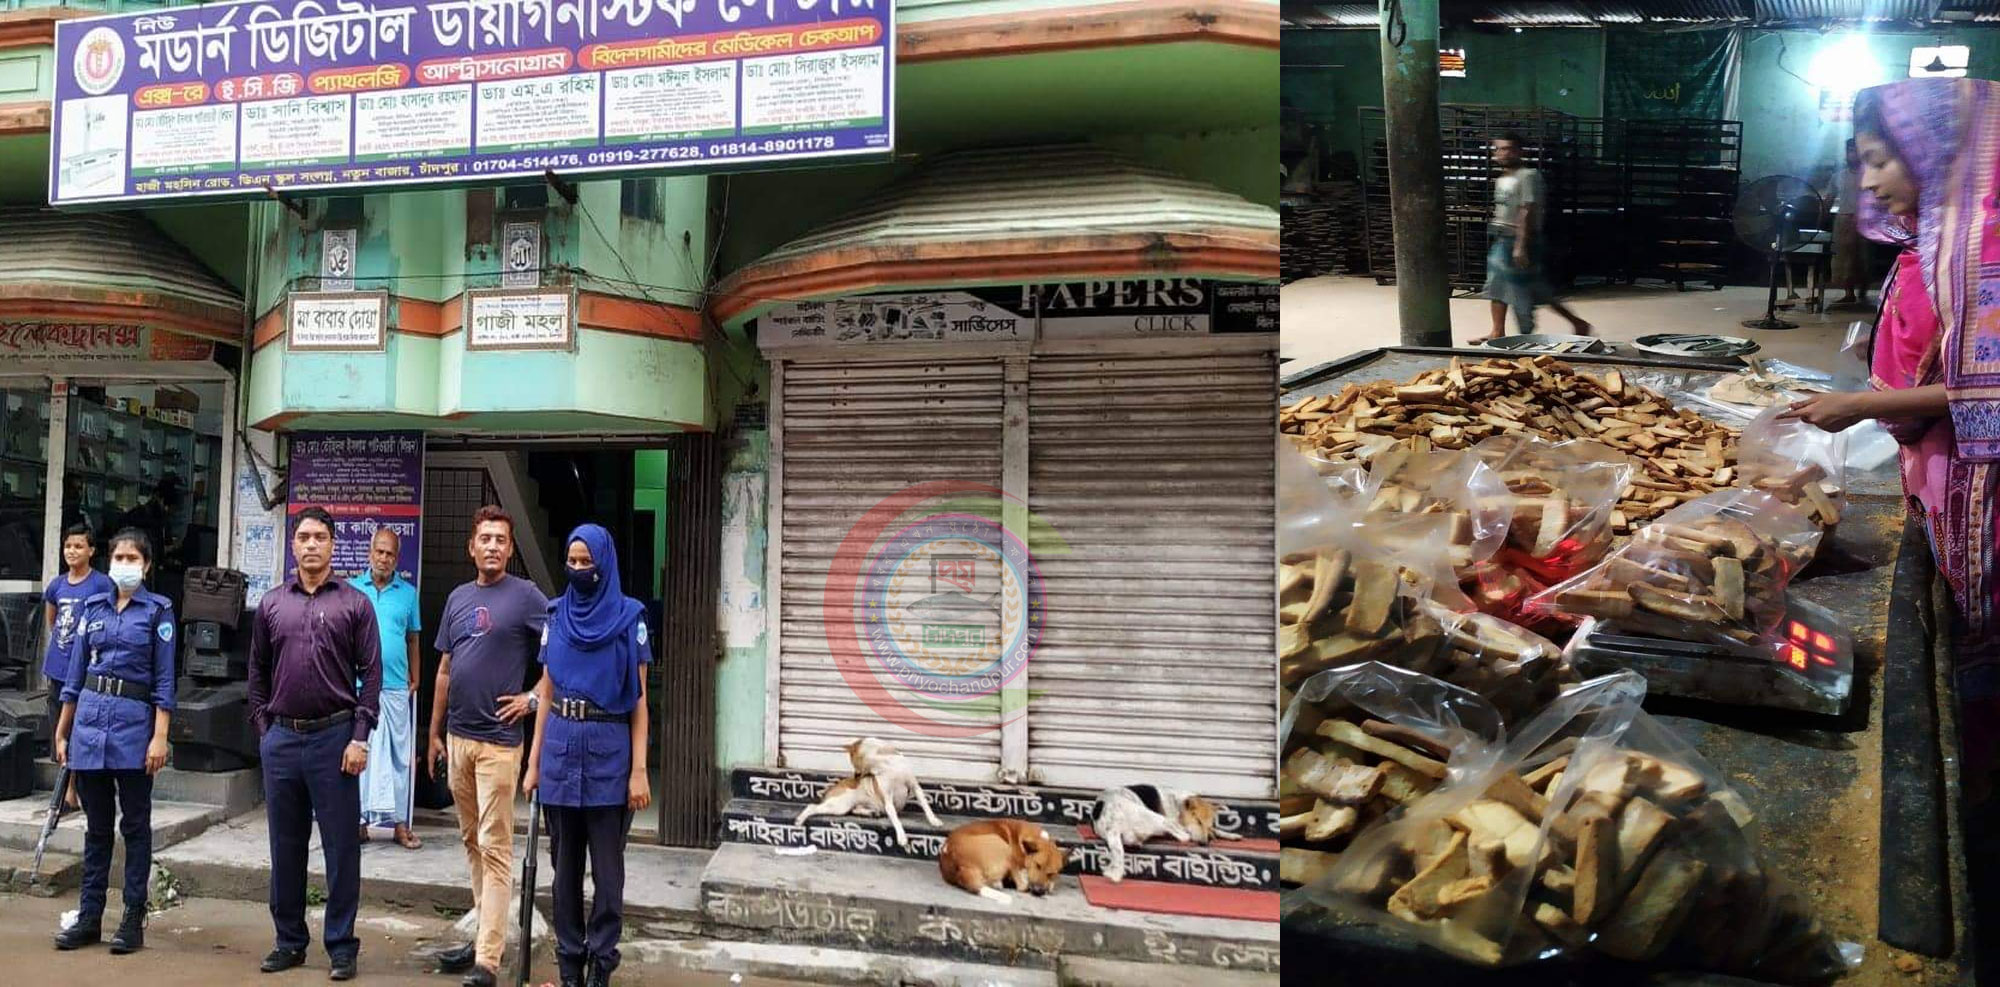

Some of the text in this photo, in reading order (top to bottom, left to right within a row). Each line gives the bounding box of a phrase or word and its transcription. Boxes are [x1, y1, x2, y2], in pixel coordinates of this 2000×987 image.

[133, 6, 238, 79] মডার্ন
[244, 0, 418, 70] ডিজিটাল
[592, 24, 876, 66] বিদেশগামীদের মেডিকেল চেকআপ
[314, 64, 402, 92] প্যাথলজি
[423, 51, 567, 82] আল্ট্রাসনোগ্রাম
[139, 84, 204, 106] এক্স-রে
[306, 99, 346, 115] বিশ্বাস
[473, 156, 583, 173] 01704-514476,
[588, 146, 705, 164] 01919-277628,
[710, 136, 835, 156] 01814-8901178
[296, 310, 311, 328] মা
[313, 310, 347, 329] বাবার
[476, 309, 518, 331] গাজী
[1134, 316, 1197, 332] CLICK
[727, 817, 807, 848] স্পাইরাল
[809, 823, 883, 853] বাইন্ডিং
[1162, 852, 1263, 886] বাইন্ডিং
